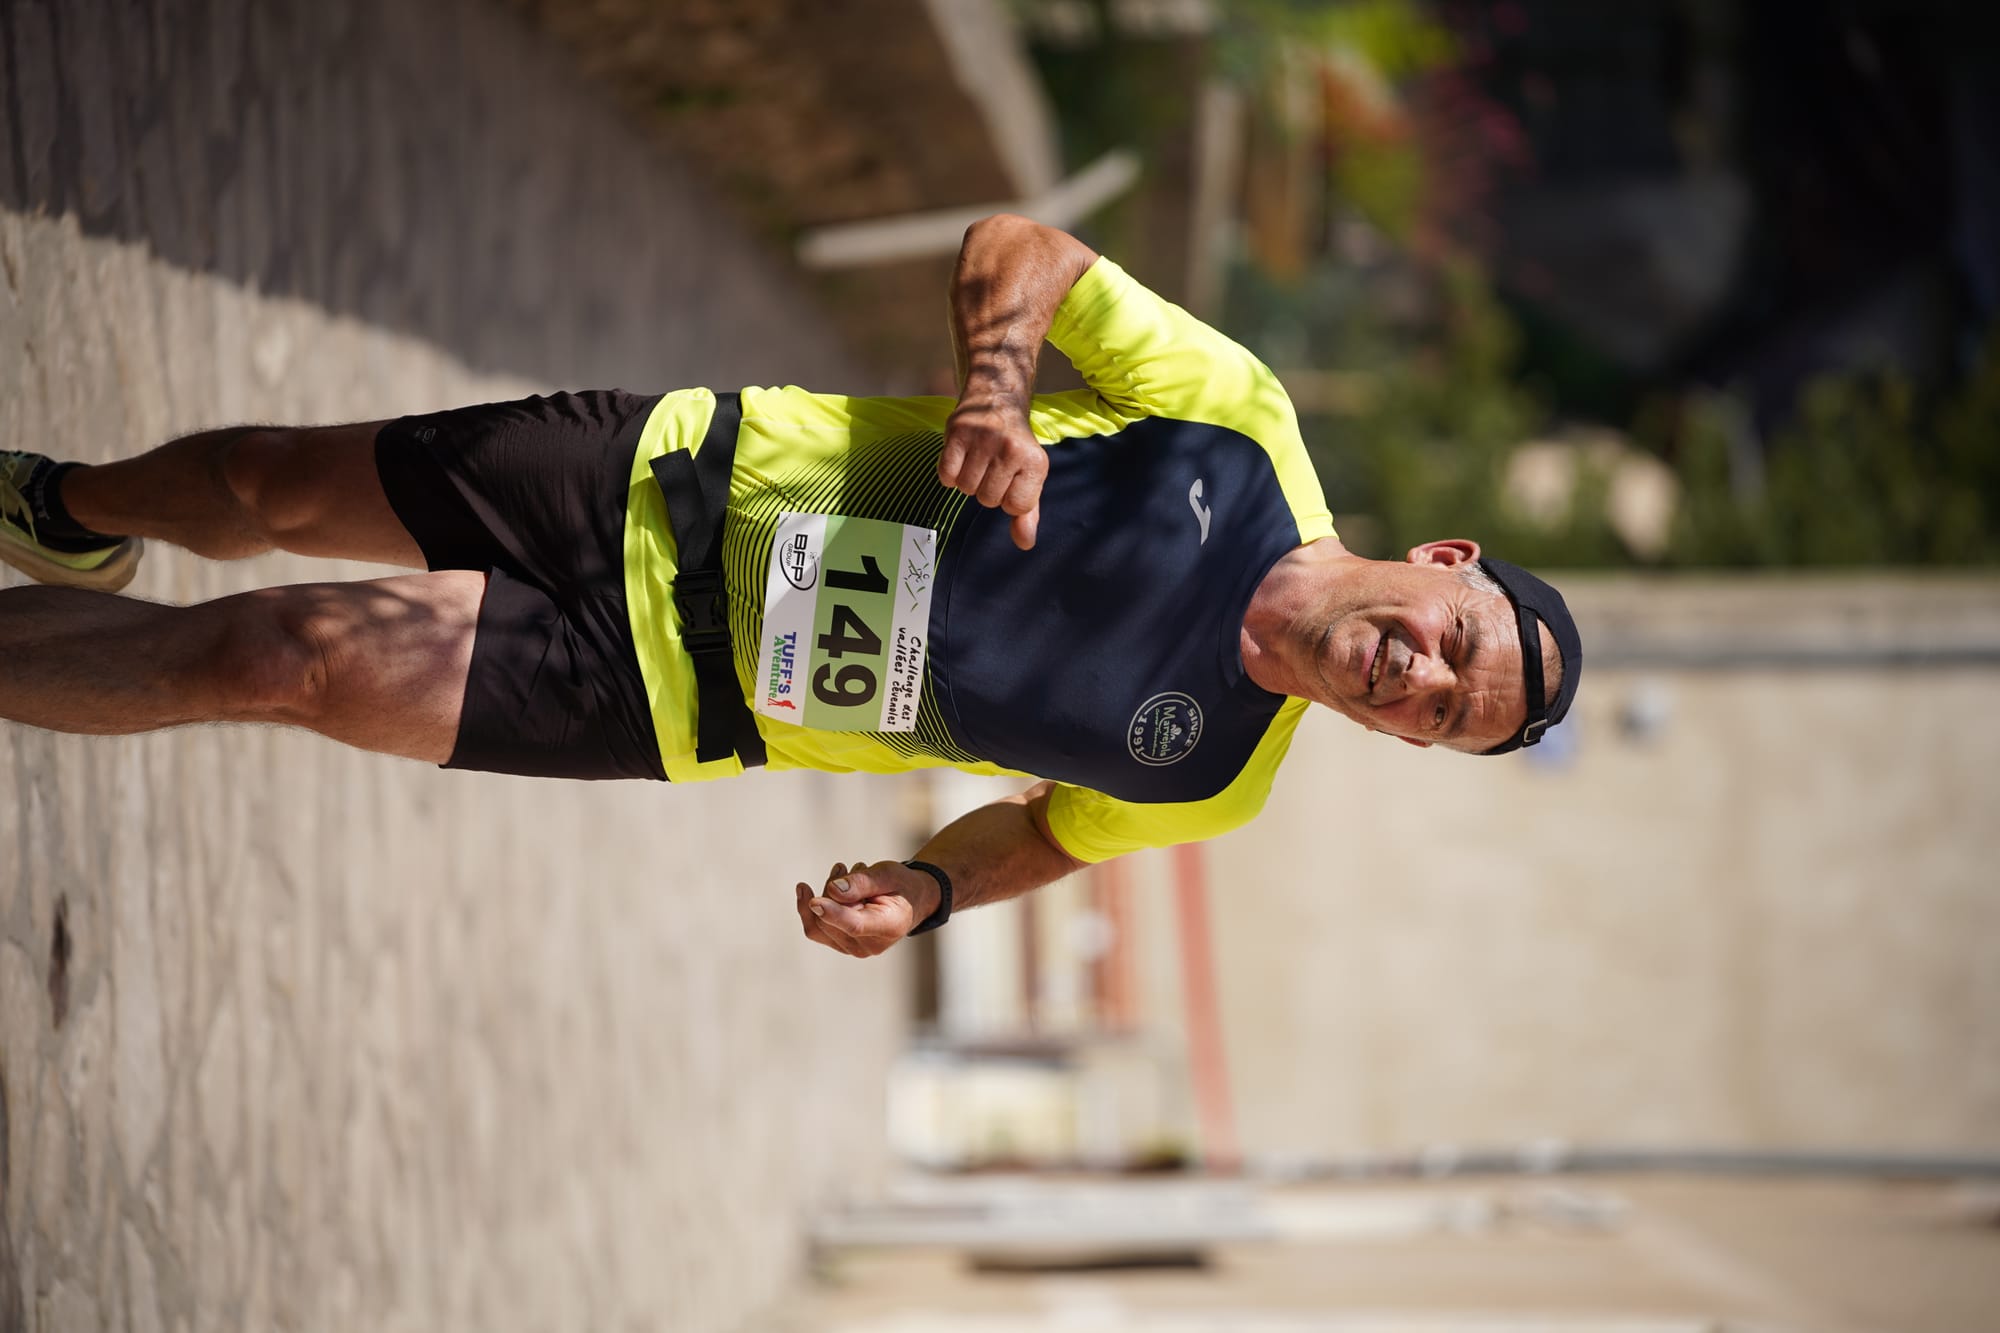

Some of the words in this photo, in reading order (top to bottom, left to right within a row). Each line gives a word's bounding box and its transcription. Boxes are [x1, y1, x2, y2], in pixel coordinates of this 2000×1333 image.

[786, 543, 794, 567] GROUP
[793, 533, 808, 582] BFP
[812, 555, 889, 707] 149
[894, 627, 907, 674] vallées
[768, 636, 784, 698] Aventure
[777, 631, 797, 694] TUFF'S
[902, 636, 922, 698] Challenge
[887, 681, 900, 726] cévenoles
[901, 703, 911, 720] des
[1184, 707, 1199, 747] SINCE
[1133, 715, 1147, 754] 1991
[1159, 706, 1177, 757] Marvejols
